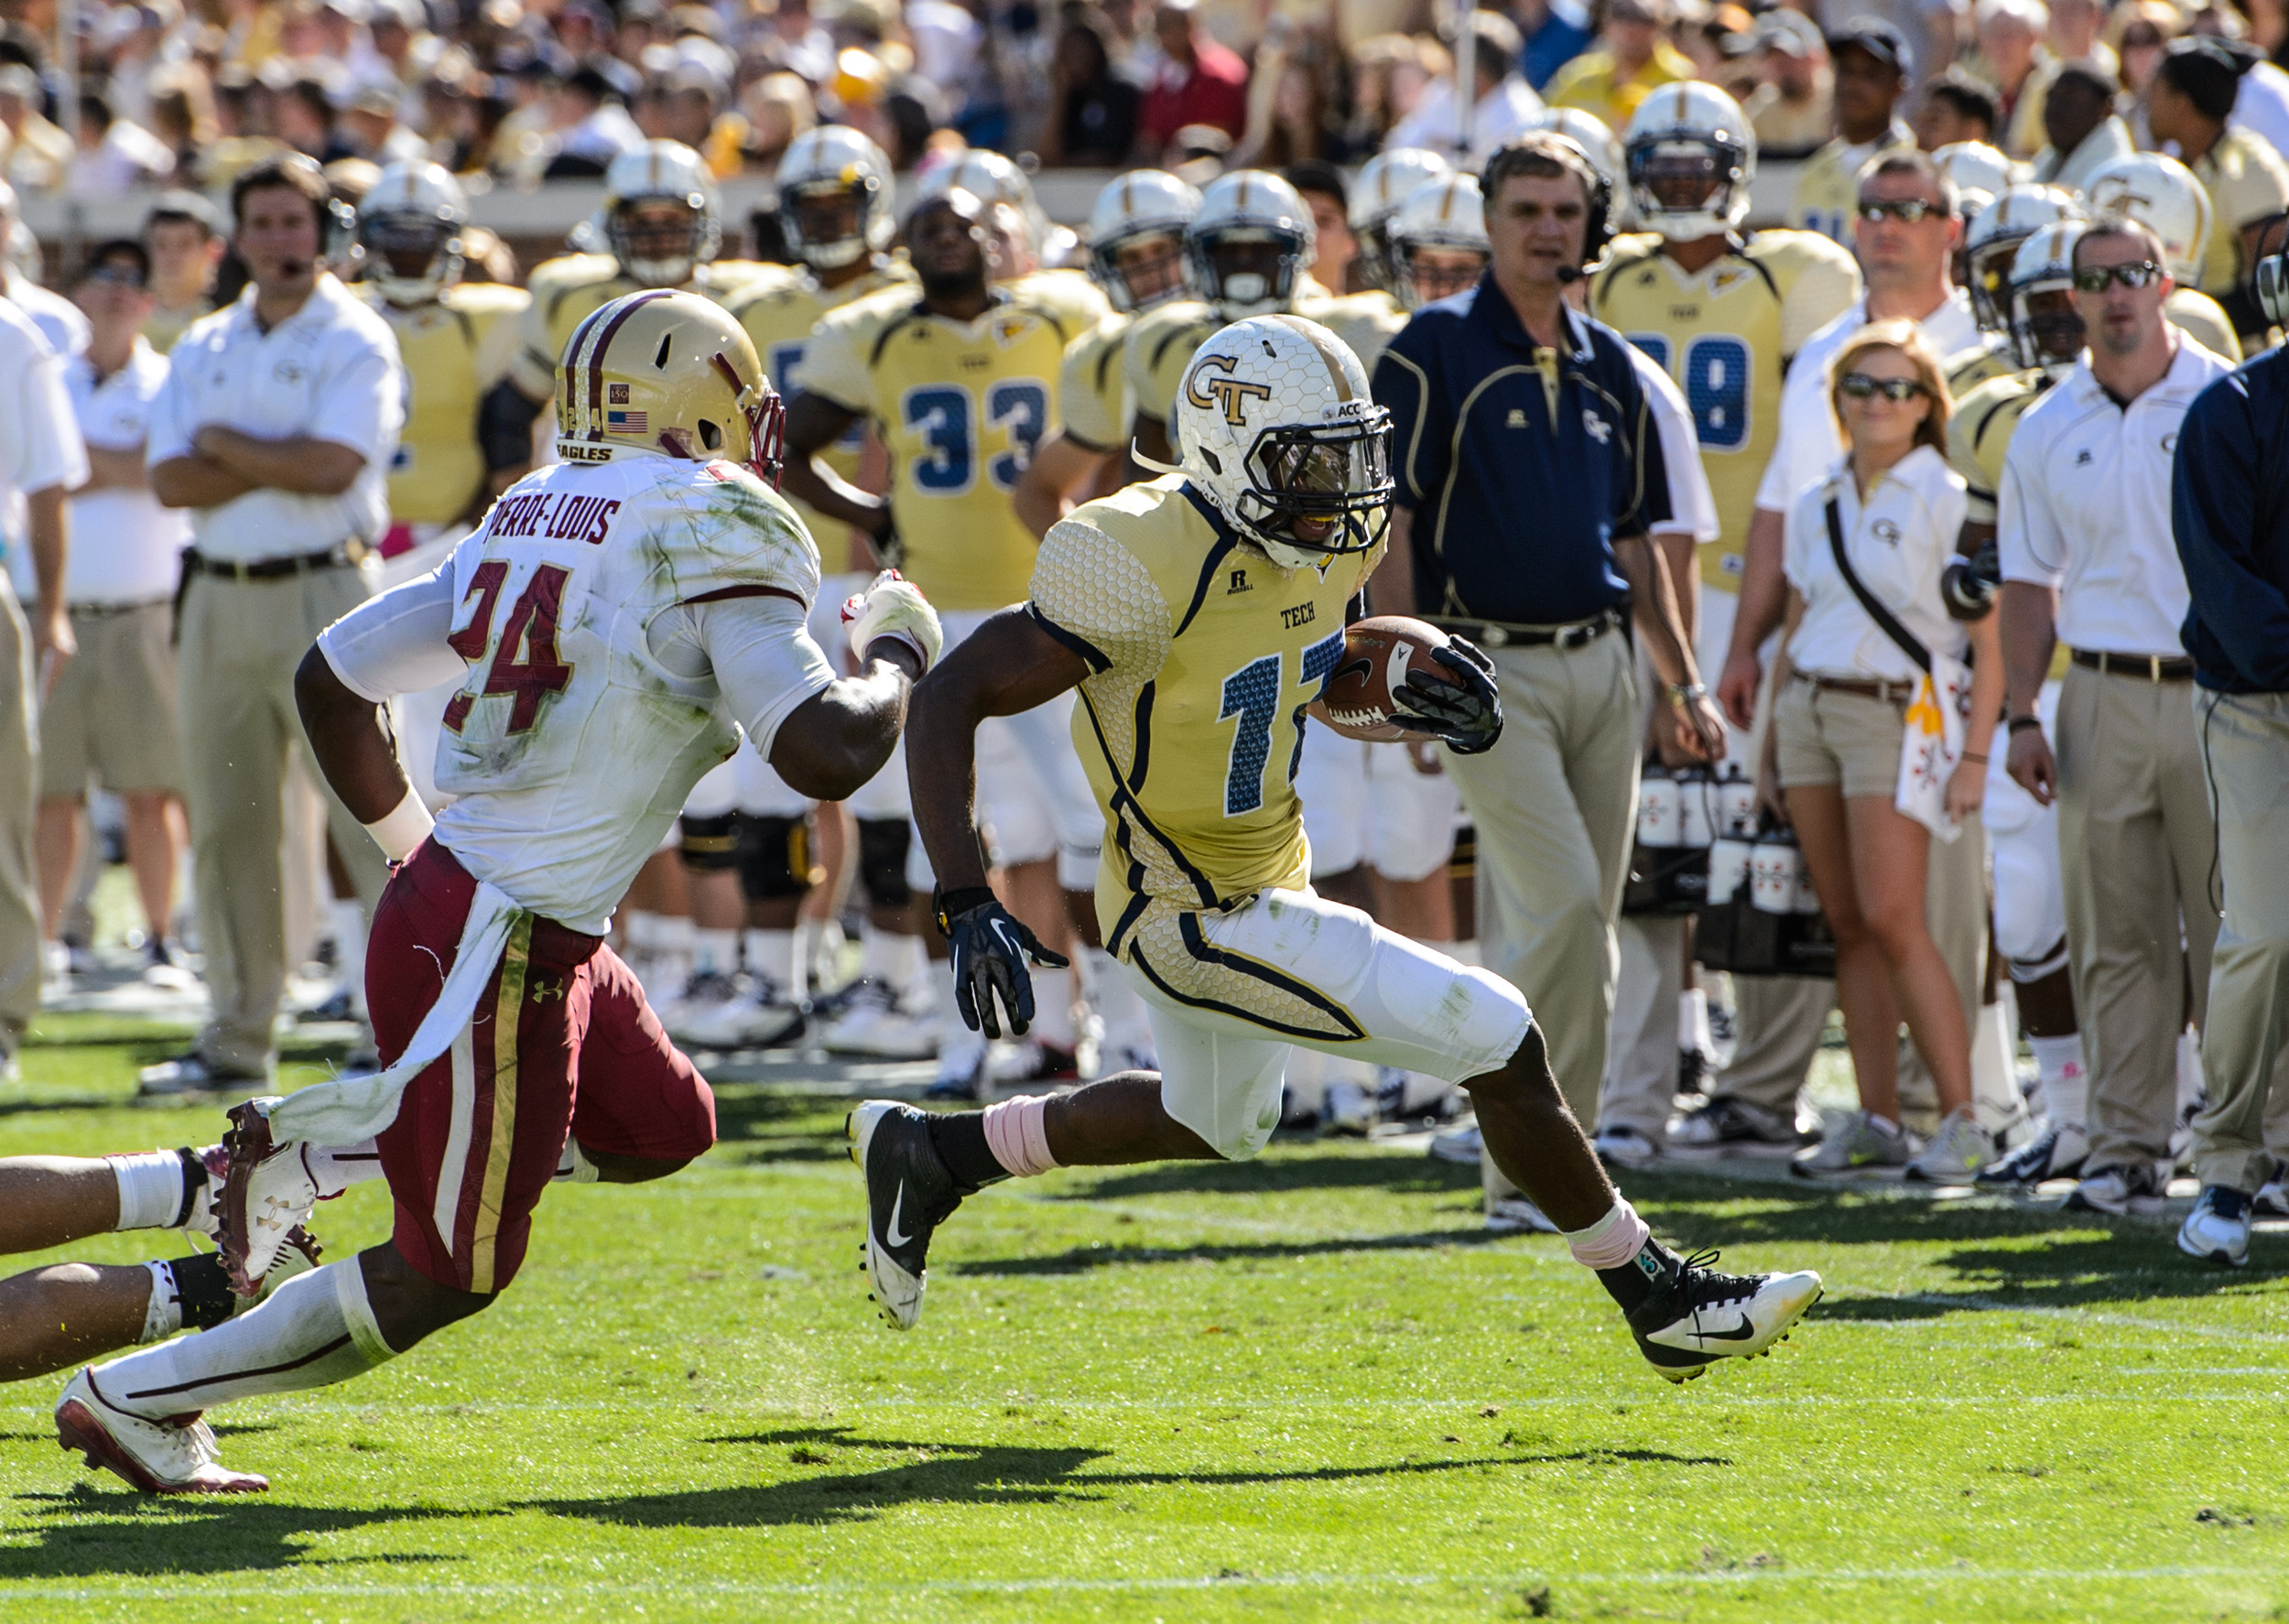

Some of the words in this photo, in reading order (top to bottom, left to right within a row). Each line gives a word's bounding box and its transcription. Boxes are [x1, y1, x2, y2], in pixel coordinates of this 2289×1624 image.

[1187, 353, 1272, 427] GT
[1338, 403, 1361, 417] ACC
[898, 377, 1052, 498] 33
[557, 444, 613, 461] EAGLES
[1227, 584, 1253, 596] RUSSELL
[1280, 601, 1316, 630] TECH
[442, 558, 575, 738] 24
